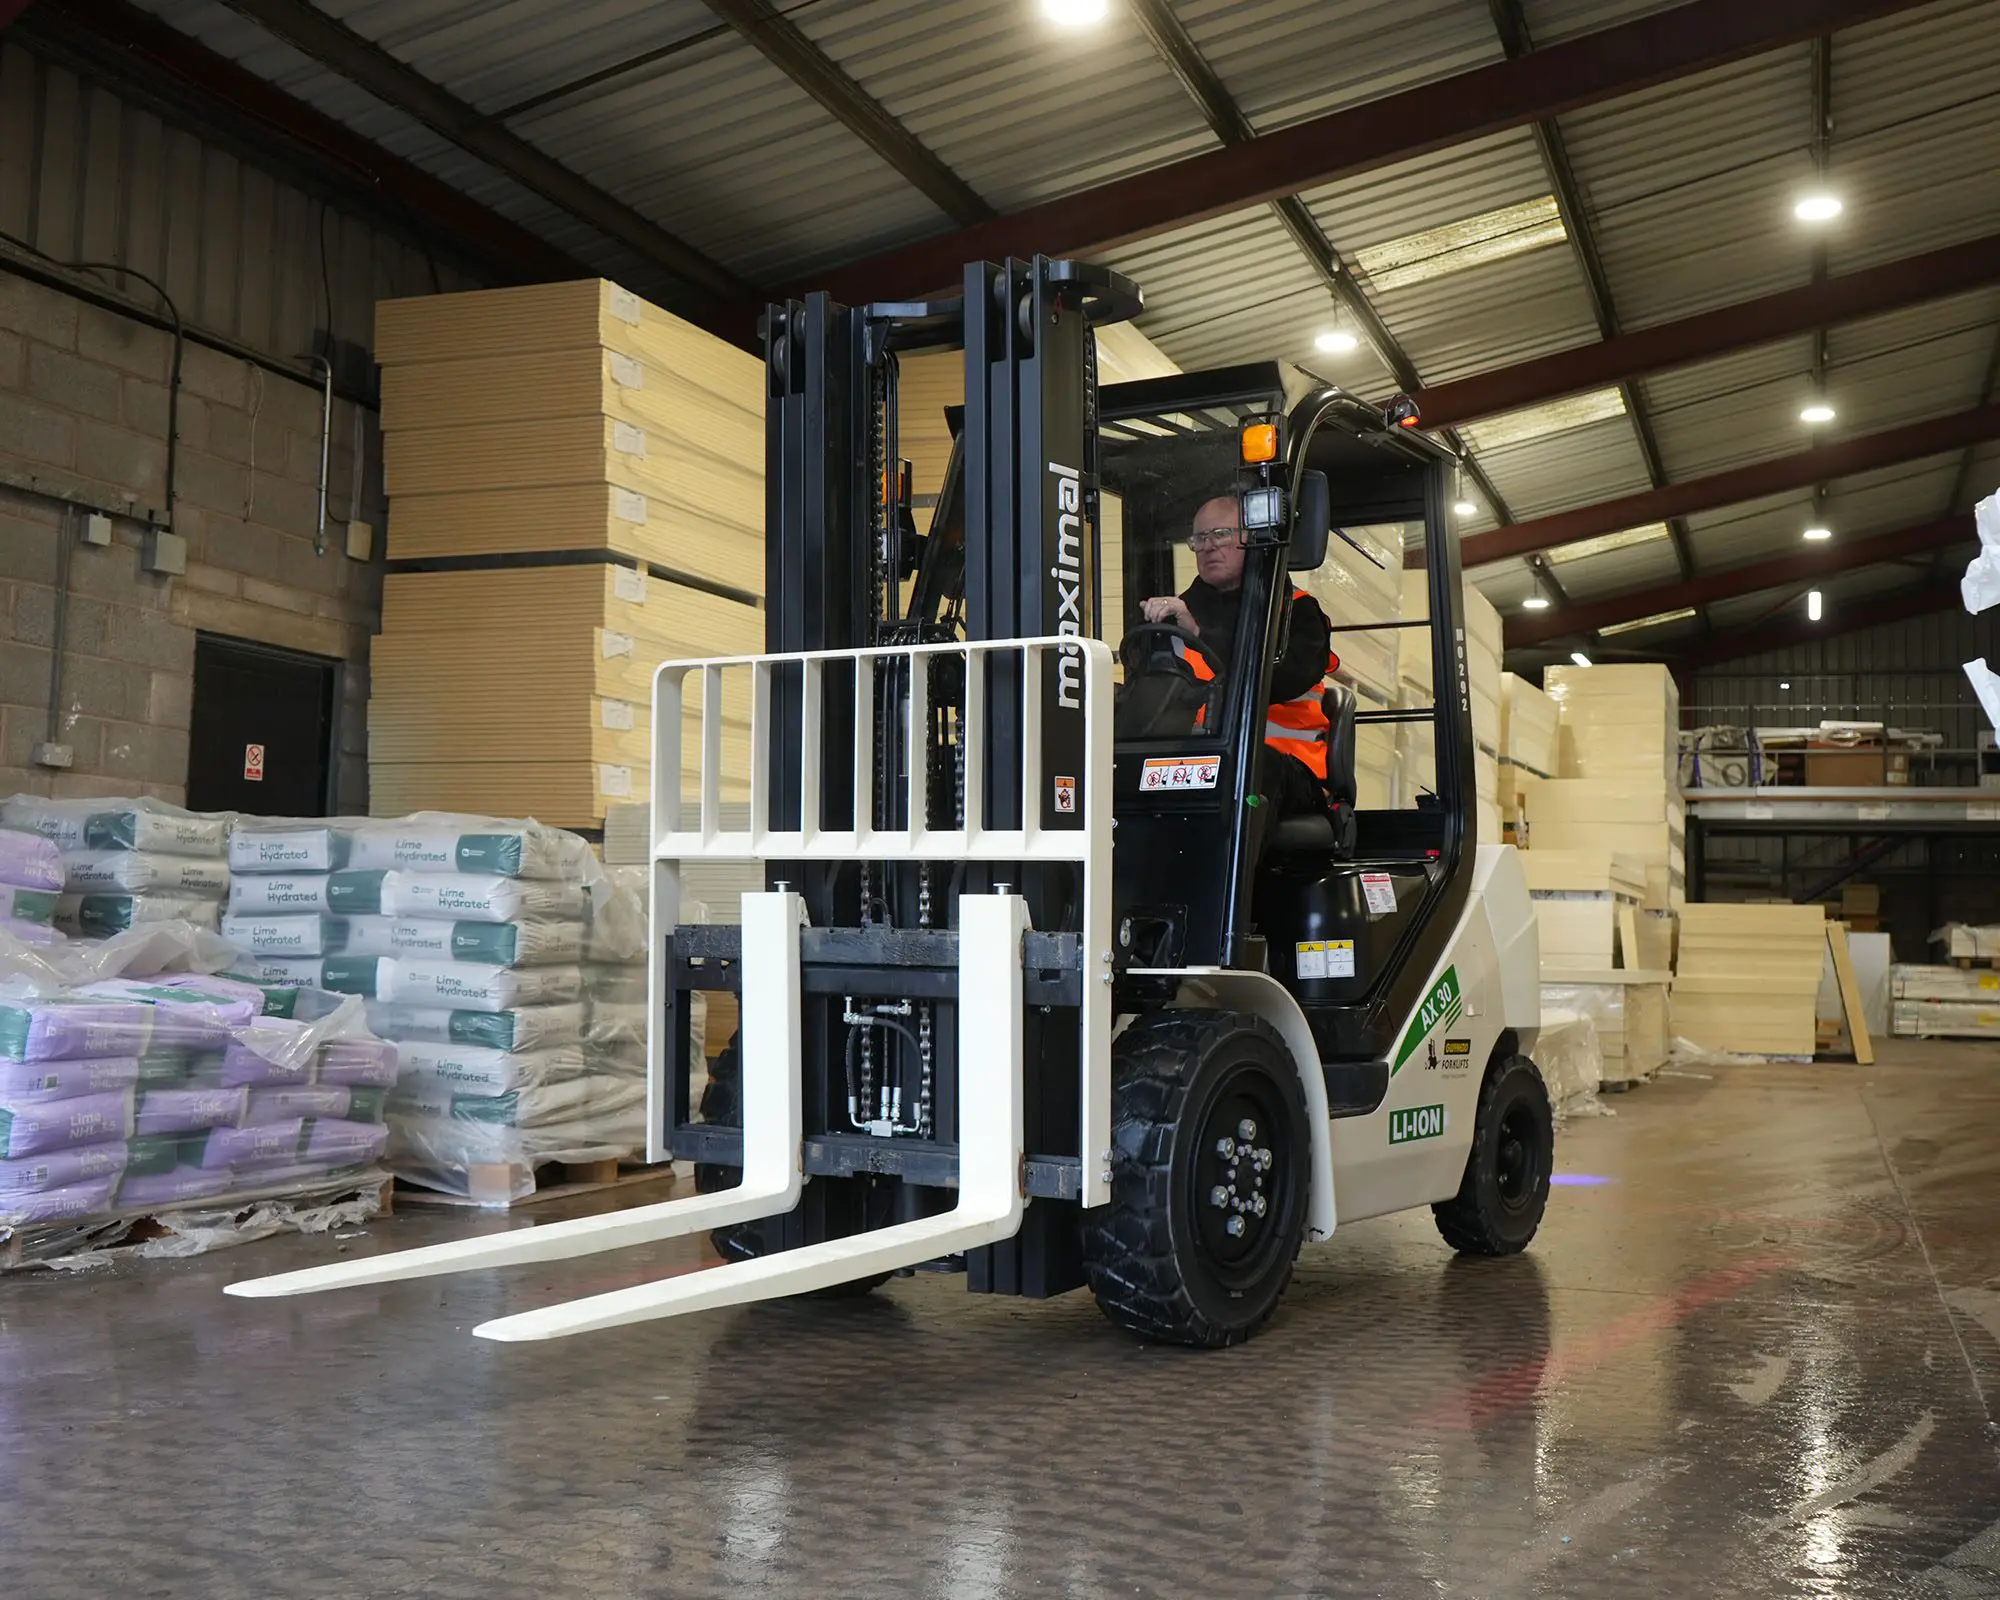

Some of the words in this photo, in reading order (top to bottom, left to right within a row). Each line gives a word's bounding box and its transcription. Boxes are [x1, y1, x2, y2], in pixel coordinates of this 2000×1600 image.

[1049, 462, 1080, 709] maximal
[260, 842, 284, 851] Lime
[395, 839, 422, 850] Lime
[260, 850, 308, 862] Hydrated
[394, 851, 447, 863] Hydrated
[71, 862, 94, 871] Lime
[182, 867, 204, 877] Lime
[71, 871, 115, 882] Hydrated
[181, 877, 223, 889] Hydrated
[268, 881, 294, 891] Lime
[267, 892, 318, 904] Hydrated
[438, 888, 465, 898] Lime
[438, 897, 490, 909] Hydrated
[252, 926, 278, 936] Lime
[391, 925, 418, 936] Lime
[252, 935, 302, 947] Hydrated
[390, 936, 442, 950] Hydrated
[262, 967, 288, 977] Lime
[436, 975, 462, 986] Lime
[435, 985, 488, 998] Hydrated
[1420, 997, 1439, 1032] AX
[1437, 981, 1452, 1010] 30
[436, 1059, 463, 1071] Lime
[1441, 1059, 1469, 1069] FORKLIFTS
[436, 1068, 490, 1082] Hydrated
[69, 1112, 102, 1127] Lime
[1392, 1107, 1441, 1141] LI-ION
[55, 1199, 88, 1212] Lime
